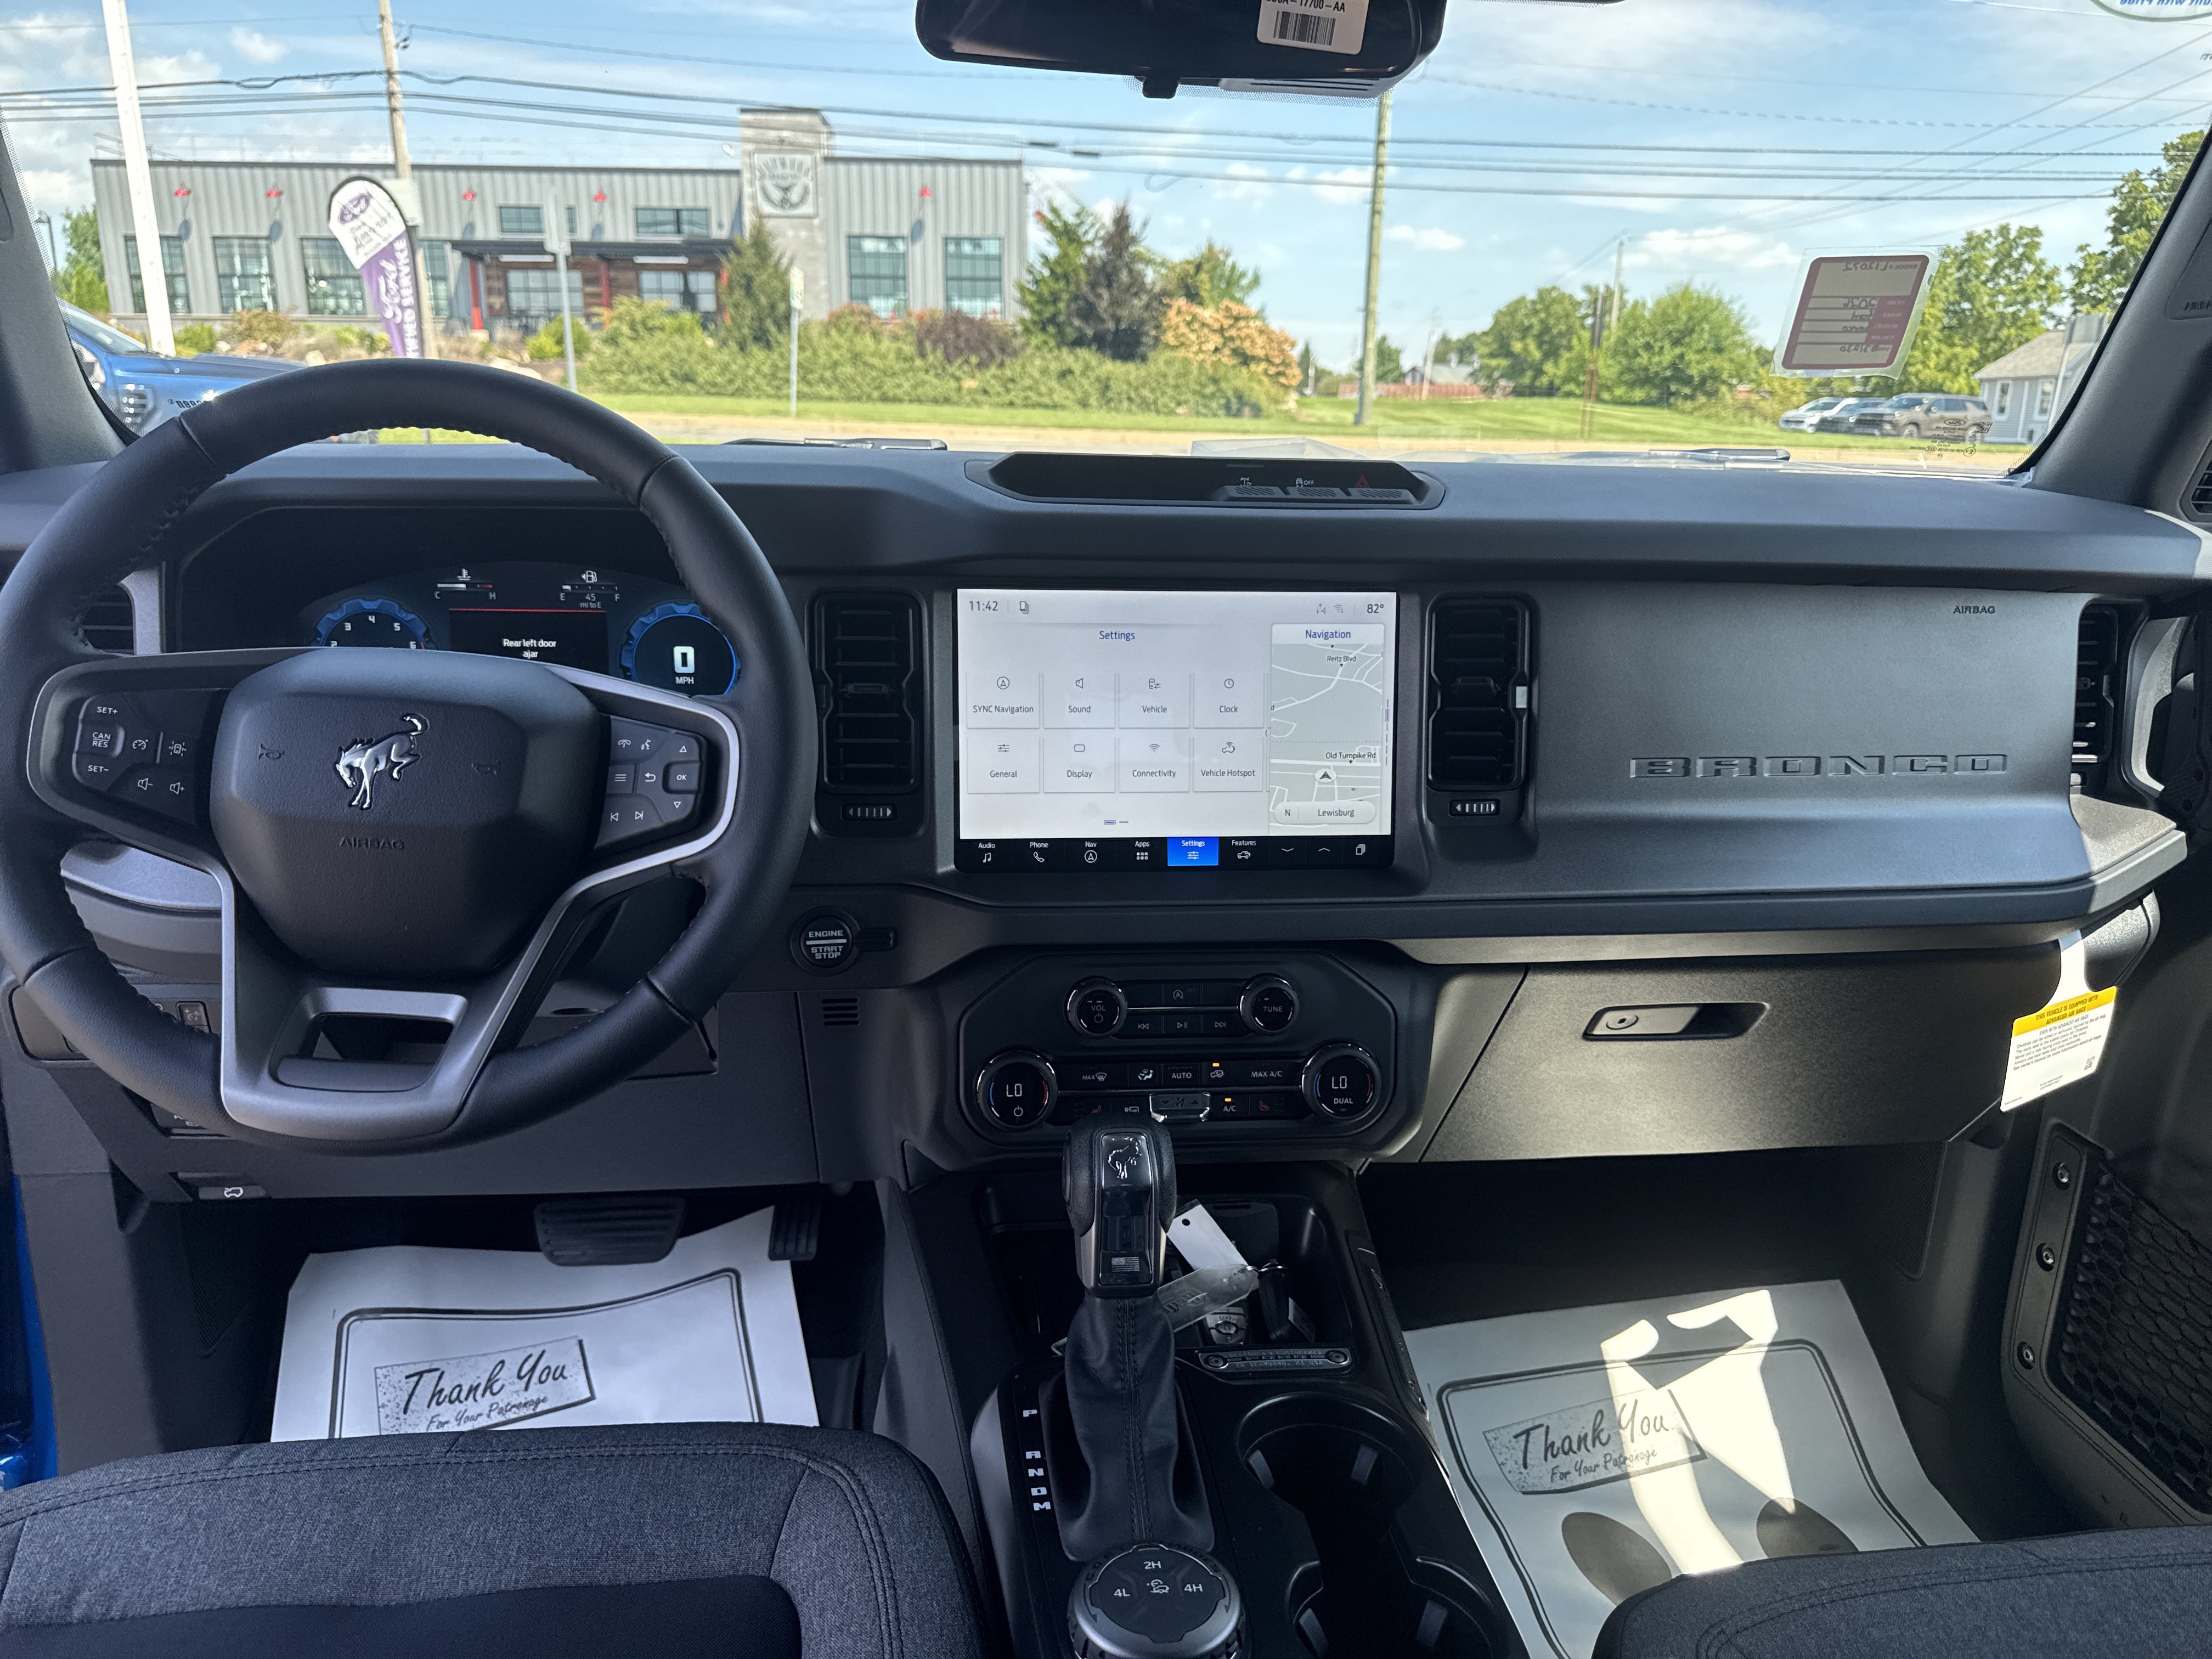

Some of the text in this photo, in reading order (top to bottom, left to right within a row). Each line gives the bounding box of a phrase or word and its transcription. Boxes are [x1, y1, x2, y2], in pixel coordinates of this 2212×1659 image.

[393, 237, 415, 307] SERVICE
[560, 593, 566, 601] E
[585, 593, 596, 602] 45
[615, 594, 620, 602] F
[969, 600, 998, 612] 11:42
[1367, 603, 1384, 613] 82°
[1953, 605, 1995, 614] AIRBAG
[368, 615, 375, 624] 4
[345, 622, 351, 631] 3
[393, 622, 400, 631] 5
[1099, 630, 1136, 641] Settings
[1305, 630, 1351, 640] Navigation
[503, 638, 557, 648] Rear left door
[523, 649, 539, 659] ajar
[673, 646, 695, 674] 0
[675, 676, 695, 685] MPH
[97, 706, 119, 715] SET+
[973, 704, 1034, 714] SYNC Navigation
[1068, 705, 1091, 713] Sound
[1142, 705, 1167, 713] Vehicle
[1219, 704, 1238, 713] Clock
[92, 731, 111, 740] CAN
[92, 740, 109, 748] RES
[1338, 752, 1367, 760] Turnpike
[1629, 753, 2008, 778] BRONCO
[990, 770, 1018, 778] General
[1066, 770, 1093, 779] Display
[1132, 769, 1176, 778] Connectivity
[1201, 769, 1255, 778] Vehicle Hotspot
[1318, 809, 1355, 817] Lewisburg
[338, 836, 405, 850] AIRBAG
[1135, 840, 1150, 849] Apps
[1331, 1076, 1347, 1090] LO
[1006, 1083, 1023, 1097] LO
[403, 1349, 567, 1415] Thank You
[426, 1396, 549, 1432] For Your Patronage
[1023, 1409, 1037, 1418] P
[1513, 1398, 1669, 1470] Thank You
[1025, 1451, 1041, 1459] R
[1550, 1448, 1658, 1483] For Your Patronage
[1028, 1468, 1044, 1477] N
[1031, 1487, 1047, 1496] D
[1033, 1501, 1051, 1511] M
[1143, 1560, 1161, 1570] 2H
[1184, 1583, 1203, 1593] 4H
[1113, 1588, 1131, 1598] 4L
